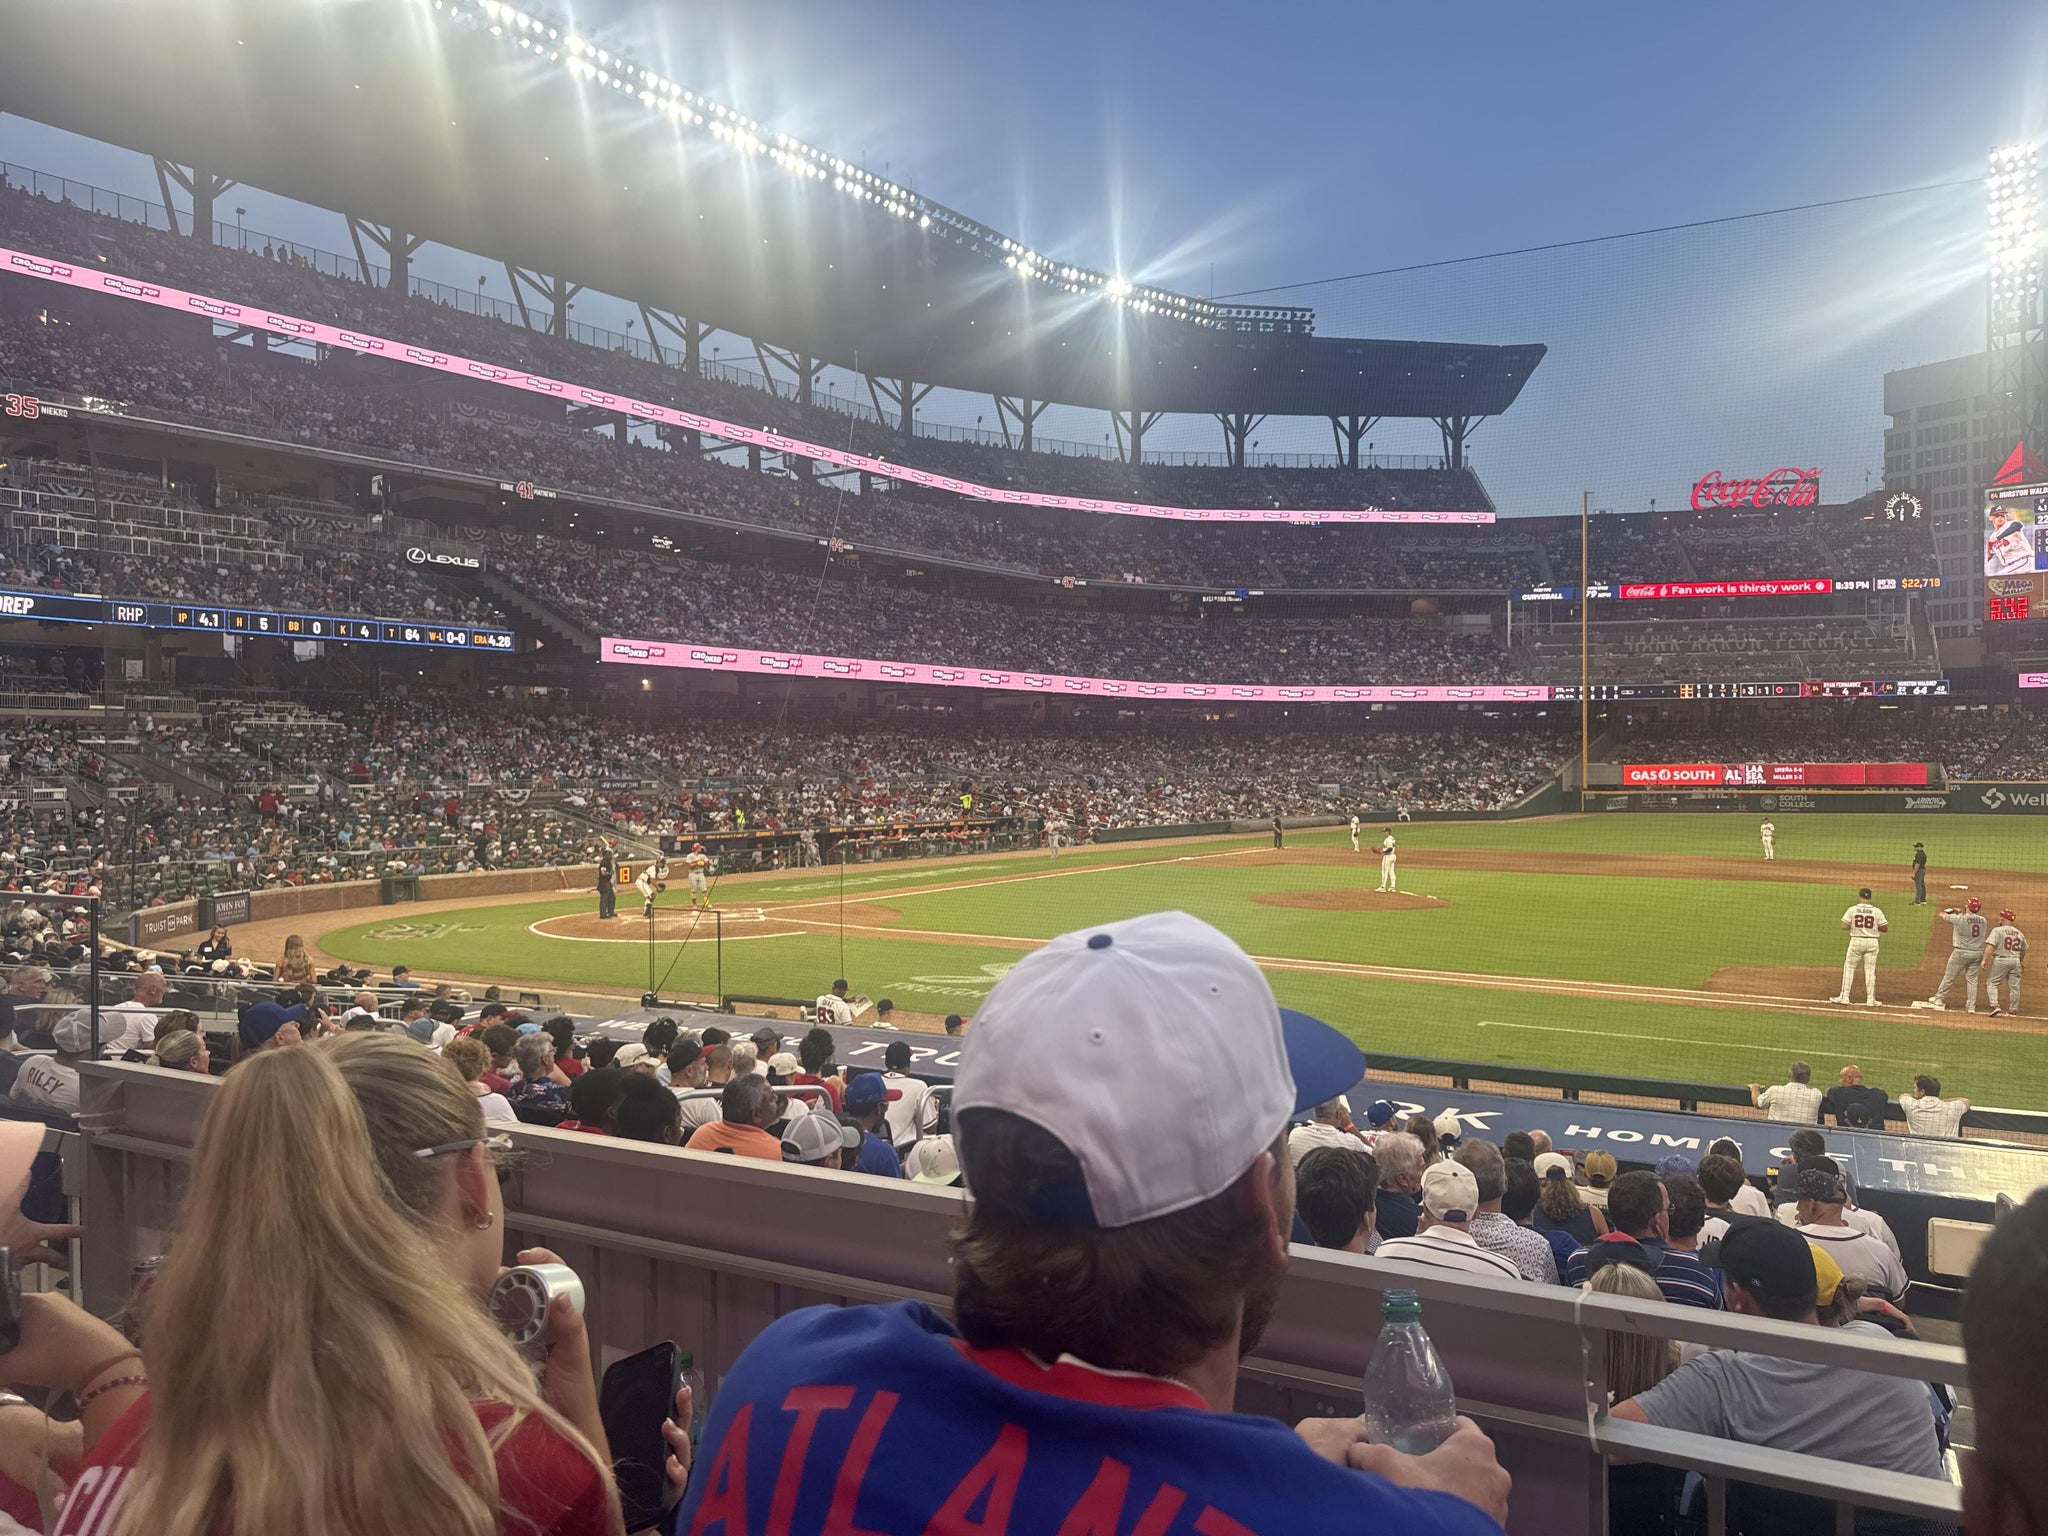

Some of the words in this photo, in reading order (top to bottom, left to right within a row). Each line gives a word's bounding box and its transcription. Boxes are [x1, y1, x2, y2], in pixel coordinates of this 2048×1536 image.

[12, 256, 52, 274] CROOKED
[54, 267, 71, 276] POP
[106, 278, 141, 295] CROOKED
[143, 288, 159, 296] POP
[190, 298, 223, 314] CROOKED
[225, 307, 240, 316] POP
[268, 317, 298, 332] CROOKED
[300, 325, 314, 333] POP
[341, 334, 369, 348] CROOKED
[371, 341, 383, 349] POP
[435, 356, 446, 364] POP
[6, 393, 39, 419] 35
[42, 406, 68, 418] NIEKRO
[516, 481, 534, 500] 41
[2000, 489, 2029, 498] HURSTON
[427, 553, 479, 568] LEXUS
[1671, 586, 1692, 595] Fan
[1694, 584, 1724, 594] work
[1727, 583, 1736, 593] is
[1739, 583, 1778, 594] thirsty
[1780, 582, 1811, 592] work
[1836, 582, 1854, 590] 8:39
[1856, 581, 1869, 589] PM
[1902, 578, 1940, 589] $22,718
[118, 607, 144, 622] RHP
[178, 613, 188, 623] IP
[200, 613, 219, 627] 4.1
[1991, 611, 2027, 620] MILLION
[236, 617, 242, 627] H
[260, 618, 268, 630] 5
[288, 621, 299, 632] BB
[313, 622, 321, 634] 0
[340, 625, 346, 635] K
[361, 626, 370, 638] 4
[389, 628, 394, 638] T
[429, 631, 443, 641] W-L
[447, 632, 466, 644] 0-0
[474, 635, 487, 645] ERA
[1625, 634, 1680, 653] HANK
[1691, 633, 1762, 651] AARON
[1766, 630, 1873, 649] TERRACE
[614, 644, 648, 658] CROOKED
[649, 647, 665, 657] POP
[692, 651, 722, 664] CROOKED
[723, 653, 737, 662] POP
[761, 657, 789, 669] CROOKED
[790, 659, 802, 667] POP
[904, 668, 915, 676] POP
[1631, 770, 1657, 781] GAS
[1673, 770, 1715, 781] SOUTH
[1725, 770, 1742, 780] AL
[1746, 765, 1763, 773] LAA
[620, 867, 630, 882] 18
[216, 902, 233, 912] JOHN
[234, 900, 246, 909] FOY
[145, 921, 166, 934] TRUIST
[176, 914, 193, 927] PARK
[1854, 915, 1874, 928] 28
[1972, 925, 1979, 937] 8
[2004, 937, 2020, 950] 82
[818, 1007, 835, 1024] 83
[27, 1067, 64, 1094] RILEY
